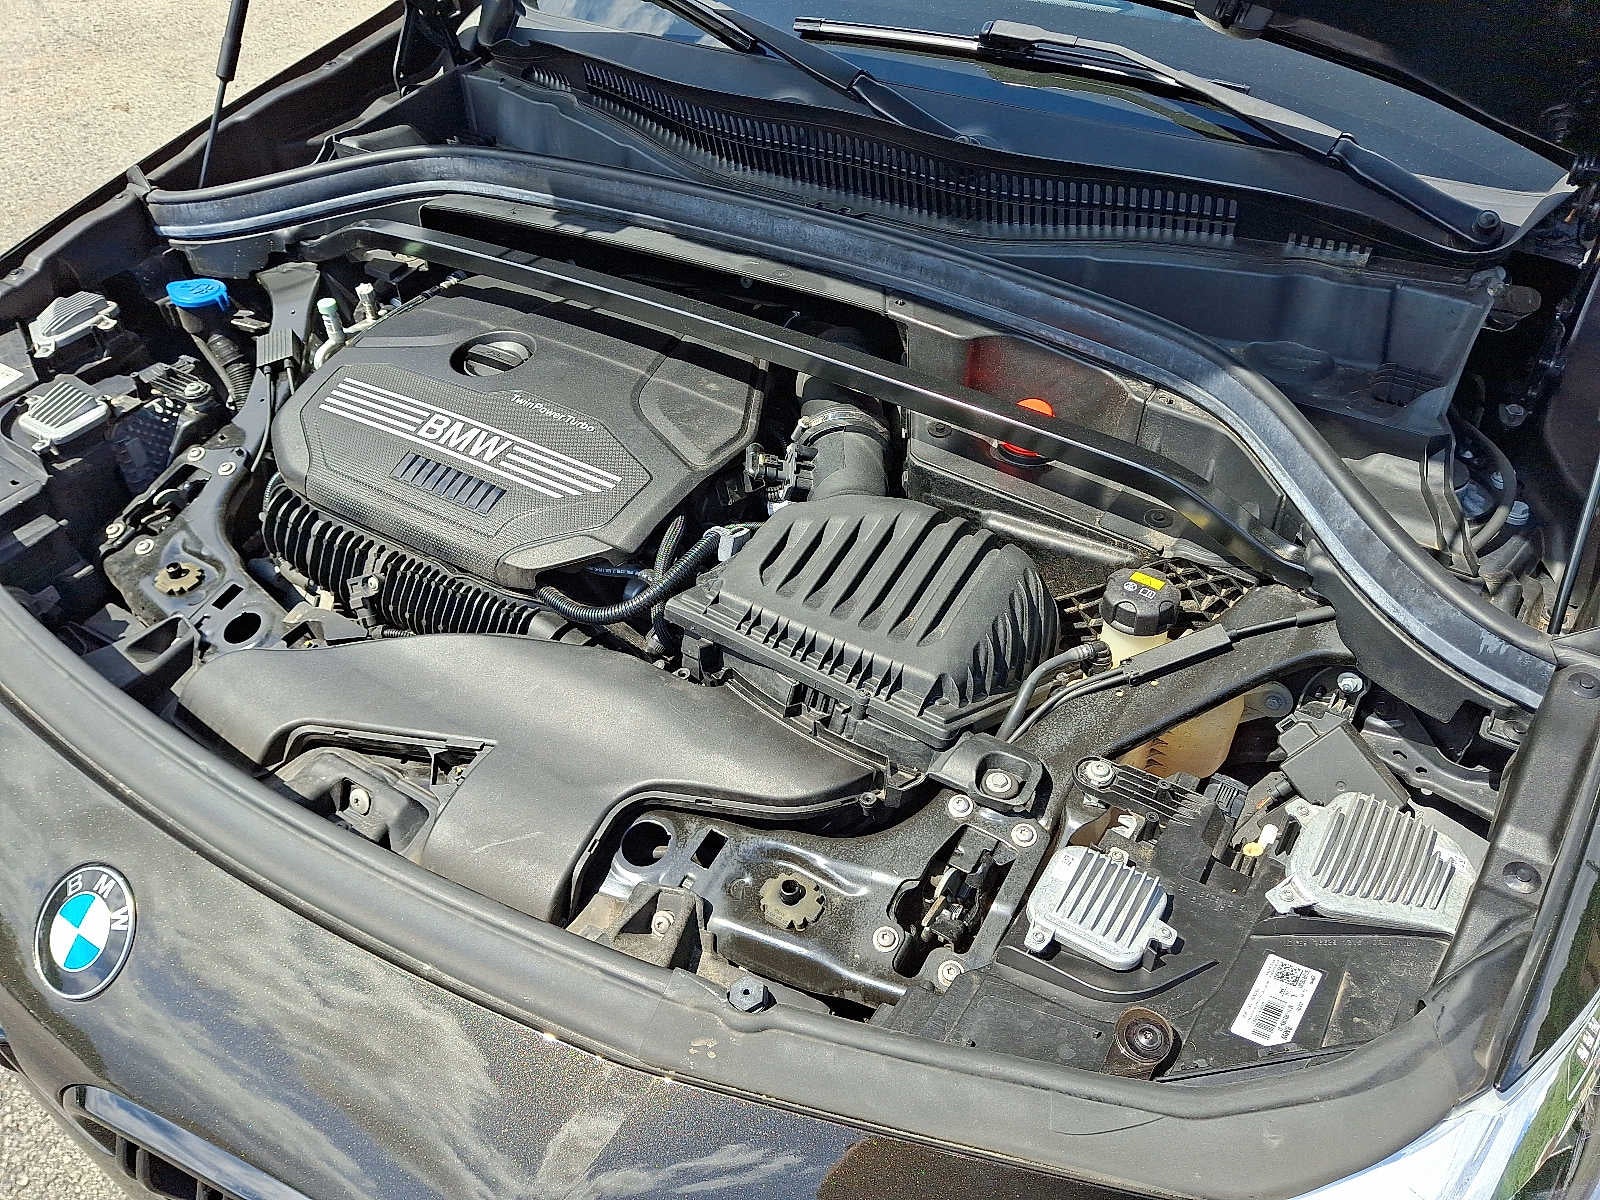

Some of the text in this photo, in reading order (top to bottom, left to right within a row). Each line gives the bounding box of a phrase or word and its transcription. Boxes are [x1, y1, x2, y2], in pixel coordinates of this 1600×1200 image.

[417, 413, 513, 462] BMW
[565, 415, 595, 432] Turbo
[67, 873, 129, 931] BMW
